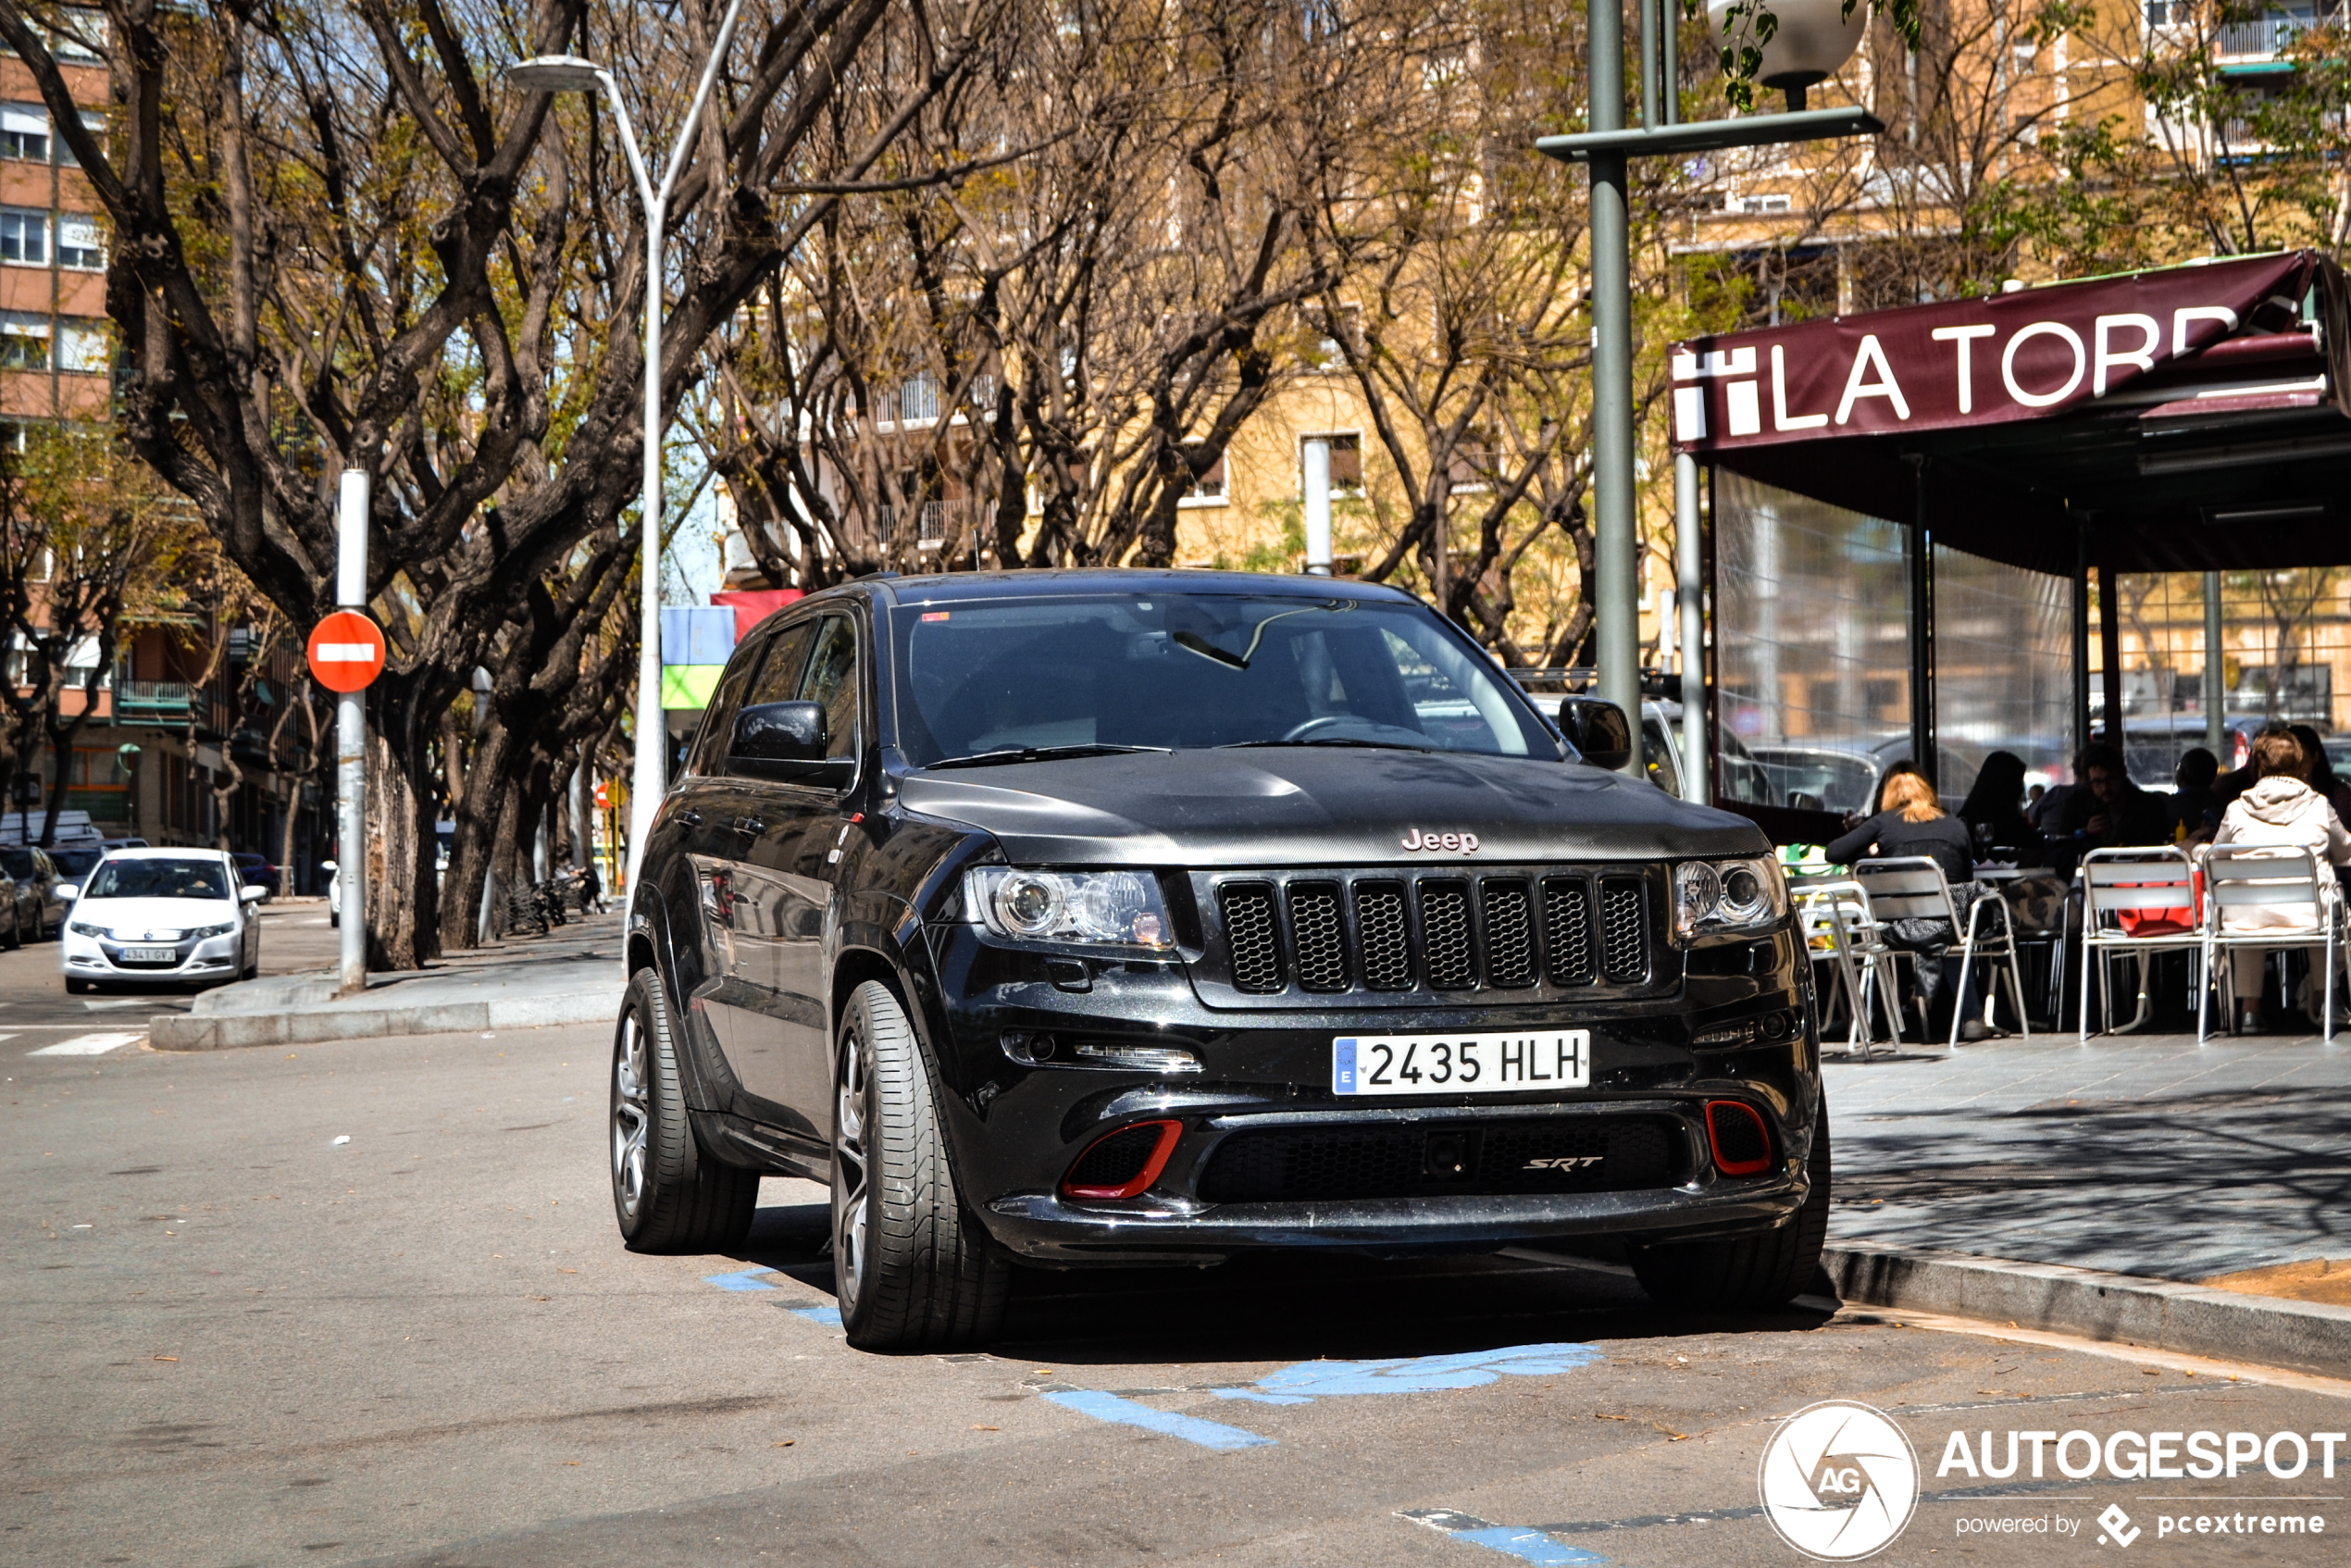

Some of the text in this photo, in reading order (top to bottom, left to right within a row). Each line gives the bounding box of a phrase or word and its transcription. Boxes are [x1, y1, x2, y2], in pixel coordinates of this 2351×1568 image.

[1771, 334, 1910, 432] LA
[1401, 828, 1479, 855] Jeep
[126, 950, 150, 960] 4341
[1369, 1038, 1579, 1085] 2435 HLH
[1341, 1071, 1351, 1083] E
[1523, 1156, 1604, 1173] SRT
